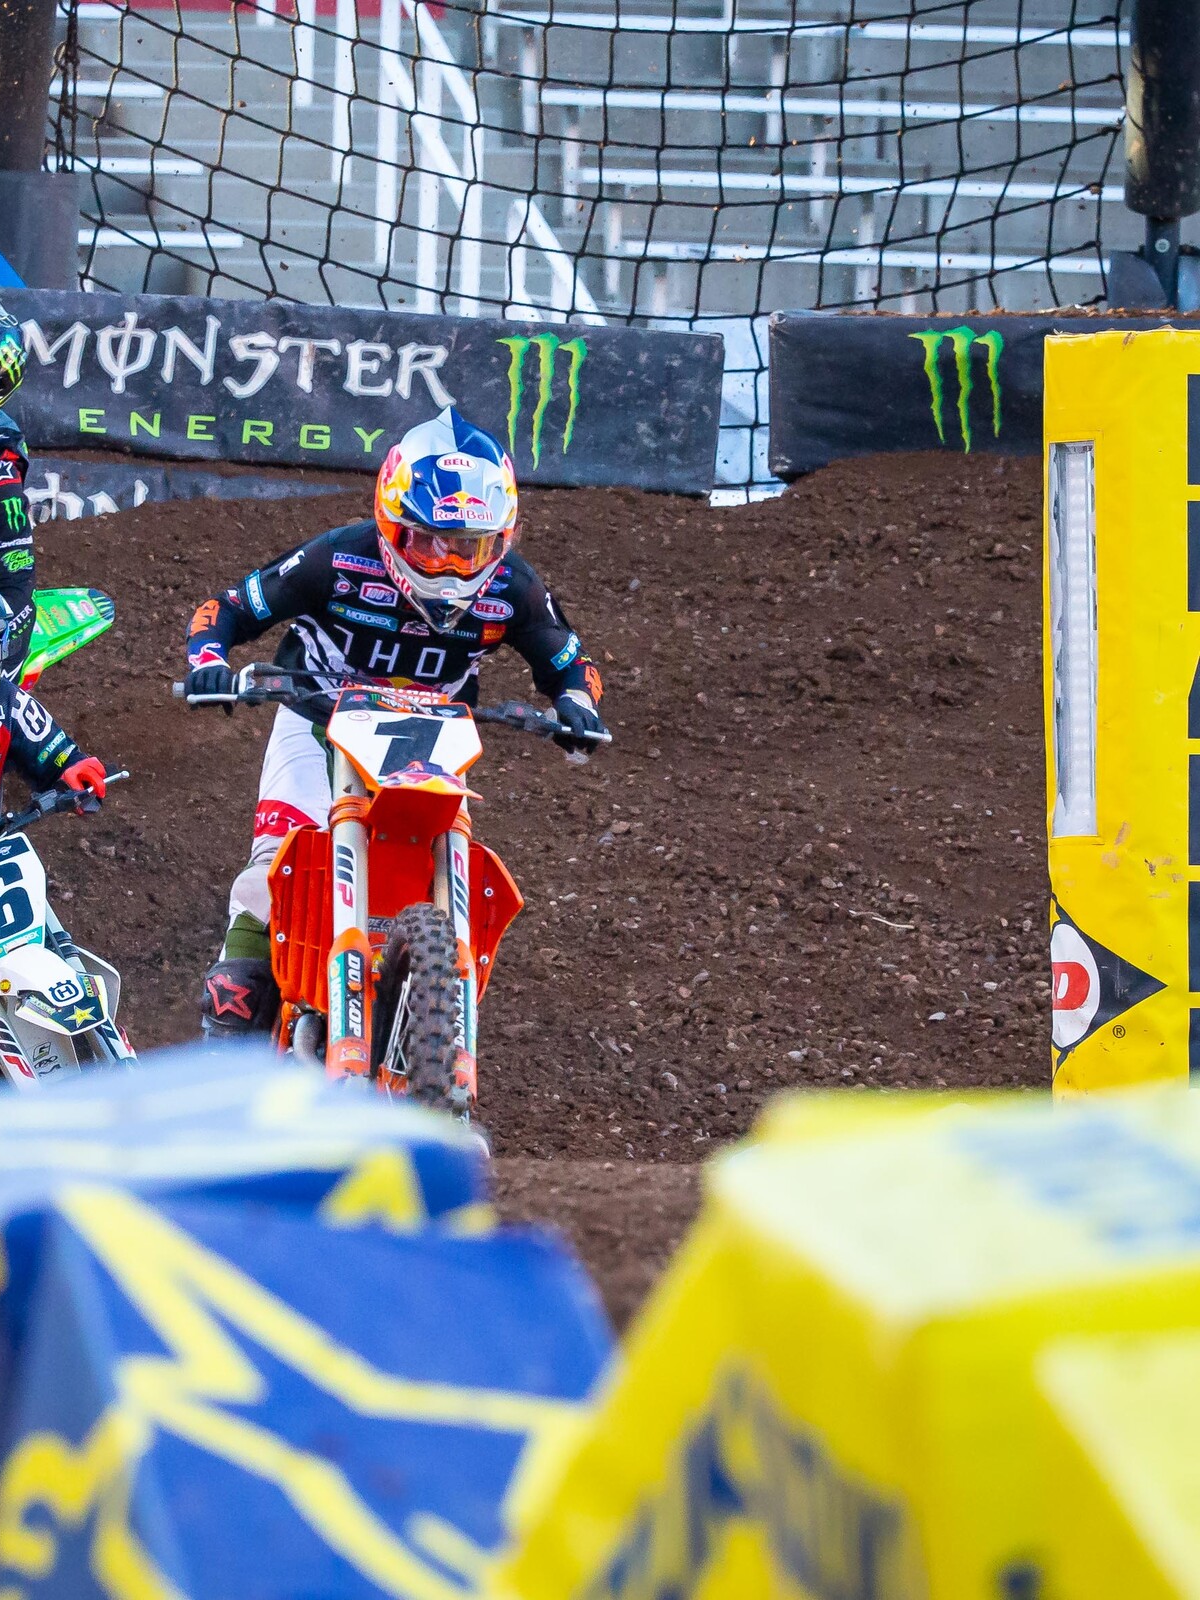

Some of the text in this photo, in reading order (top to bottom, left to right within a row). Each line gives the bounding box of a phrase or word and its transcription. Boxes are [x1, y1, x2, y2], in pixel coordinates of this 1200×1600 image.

[20, 311, 456, 407] MONSTER
[79, 408, 384, 453] ENERGY
[443, 458, 473, 468] BELL
[434, 509, 493, 522] Red Bull
[8, 604, 33, 631] STER
[346, 609, 392, 628] MOTOREX
[474, 602, 507, 616] BELL
[374, 716, 445, 777] 1
[348, 952, 363, 1038] DULOP
